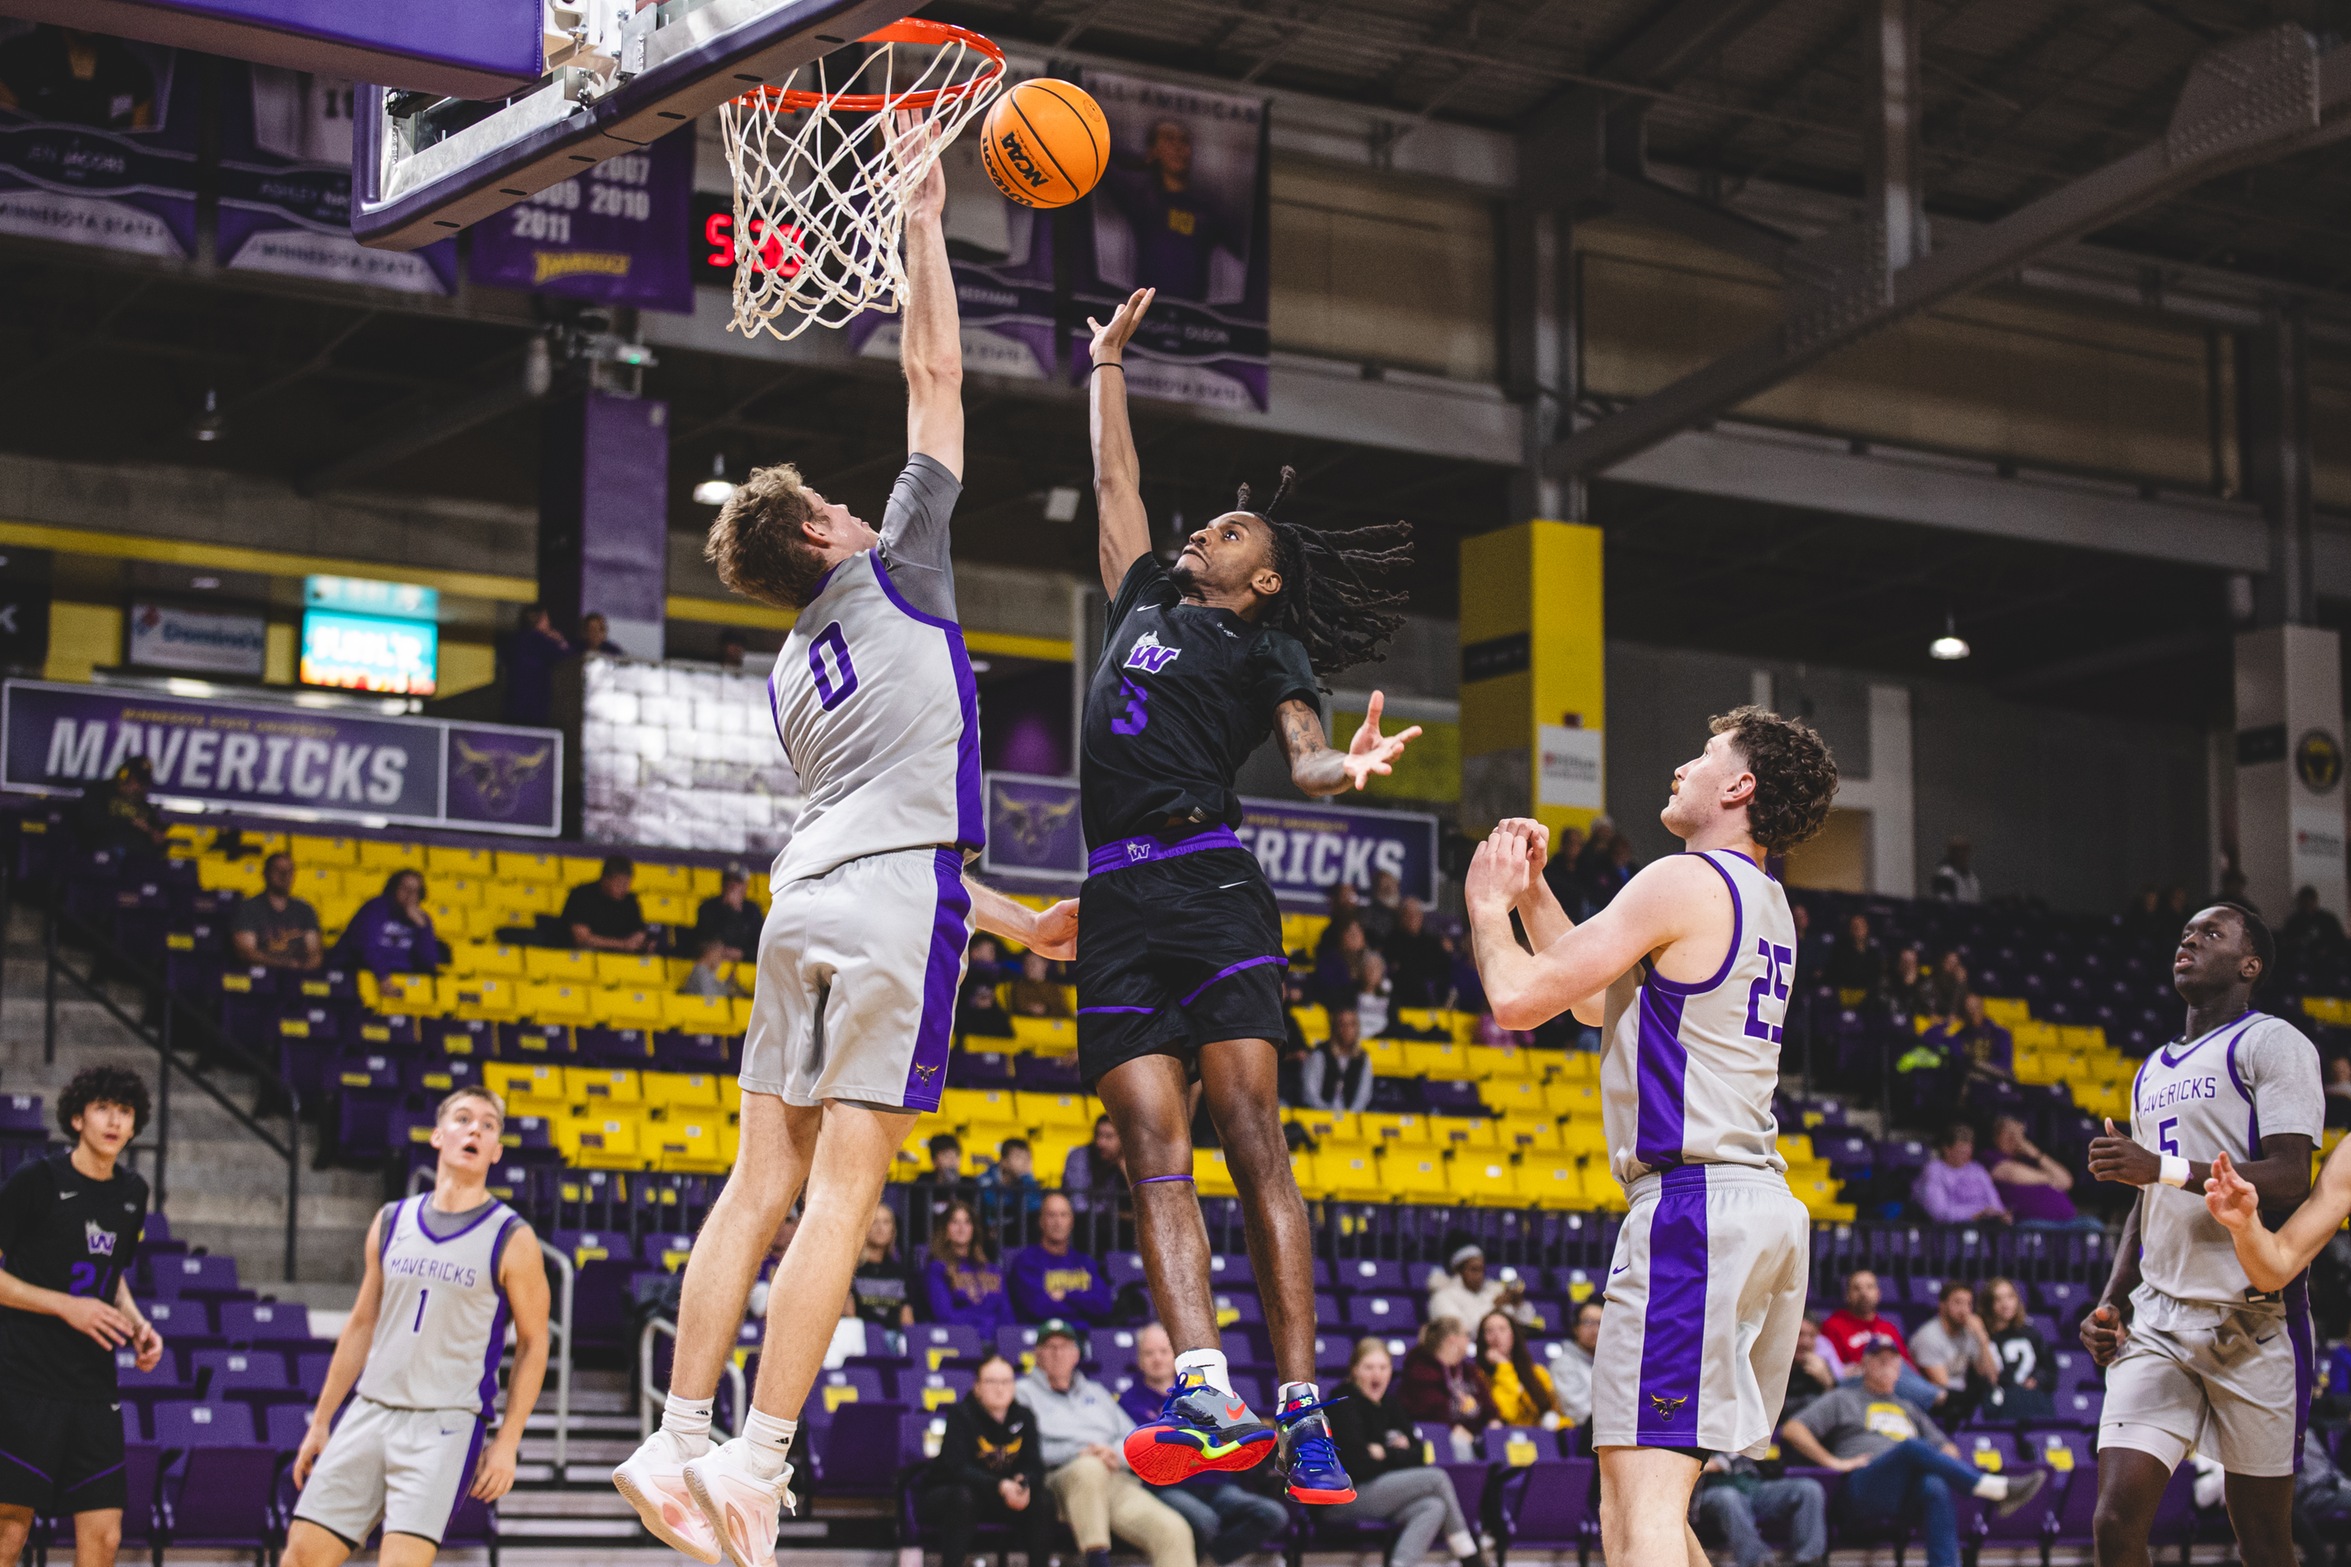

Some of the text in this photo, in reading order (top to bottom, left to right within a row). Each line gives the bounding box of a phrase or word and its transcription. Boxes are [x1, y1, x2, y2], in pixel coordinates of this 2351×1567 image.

[1001, 131, 1050, 188] NCAA
[590, 183, 650, 222] 2010
[512, 206, 571, 244] 2011
[809, 620, 859, 712] 0
[1123, 644, 1181, 674] W
[1111, 677, 1149, 736] 3
[46, 717, 409, 805] MAVERICKS
[1742, 935, 1792, 1047] 25
[2159, 1116, 2179, 1157] 5
[86, 1230, 118, 1257] W
[389, 1257, 477, 1290] MAVERICKS
[413, 1288, 429, 1334] 1
